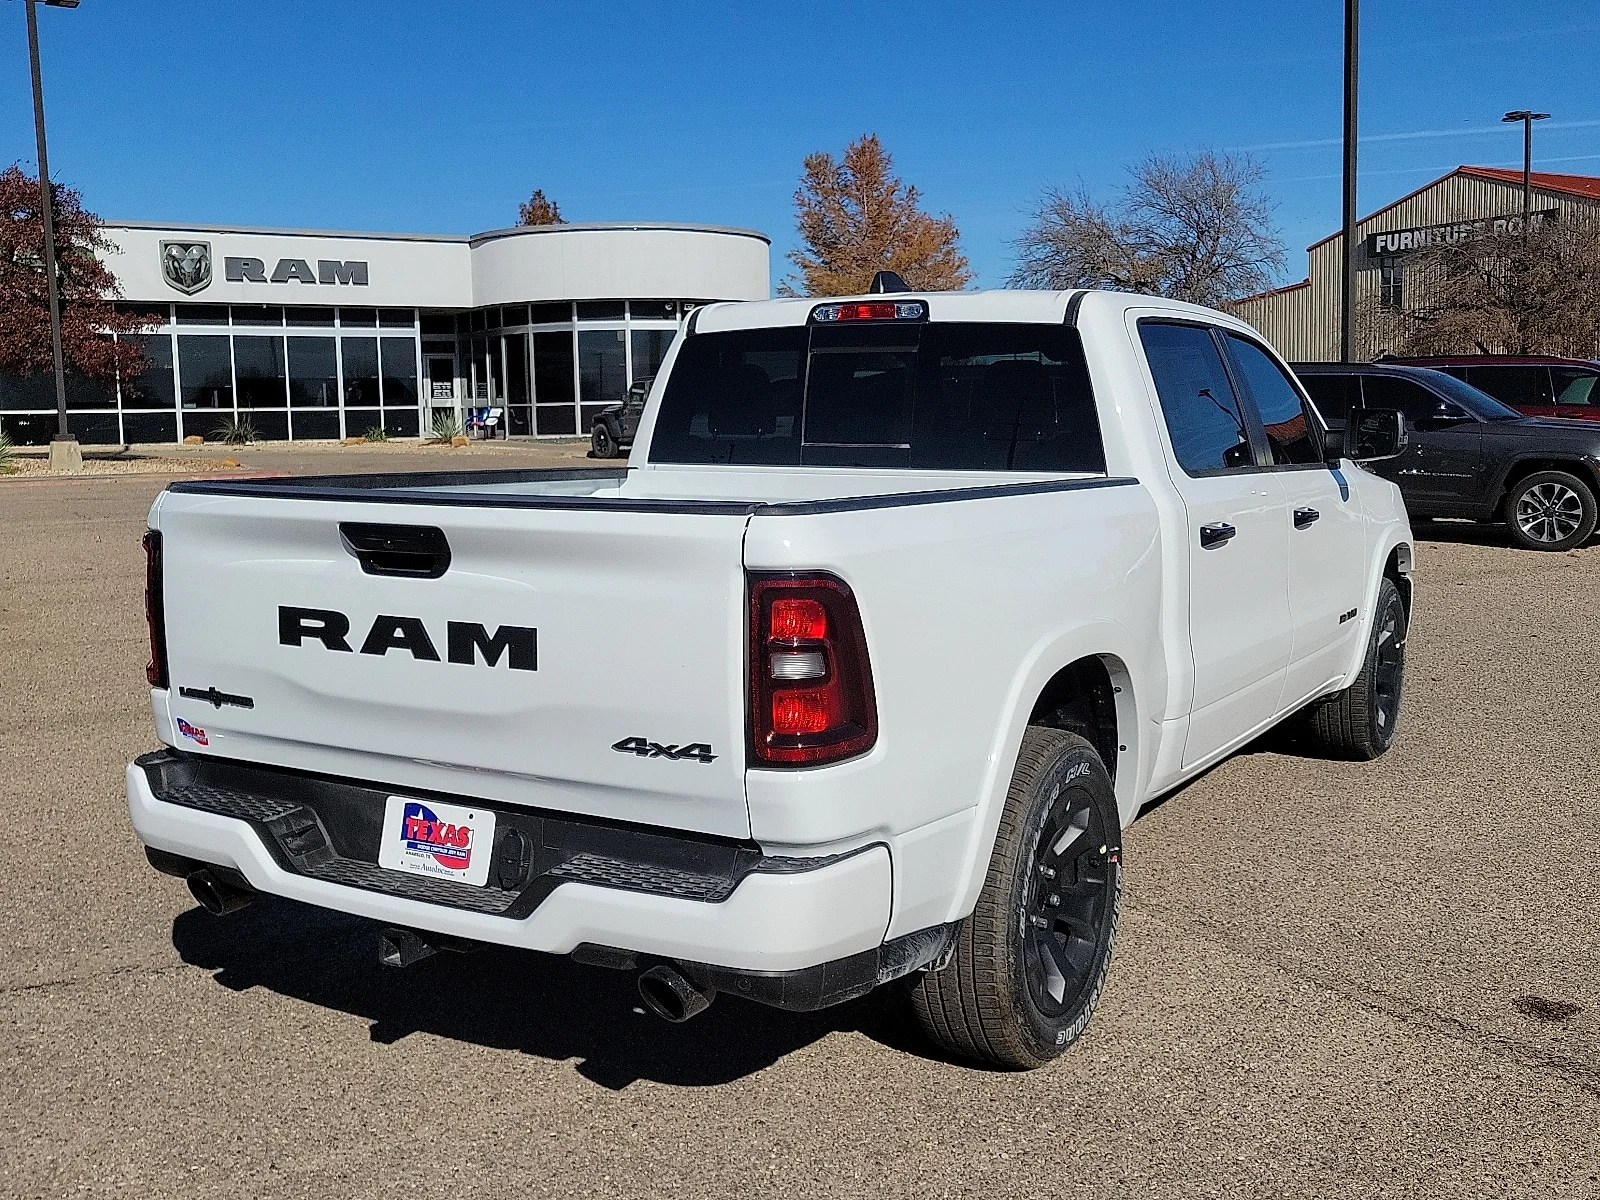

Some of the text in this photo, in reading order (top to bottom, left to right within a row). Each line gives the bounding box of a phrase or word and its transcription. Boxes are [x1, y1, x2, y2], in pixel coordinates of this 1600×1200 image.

[224, 256, 369, 286] RAM
[278, 605, 538, 671] RAM
[405, 817, 472, 849] TEXAS
